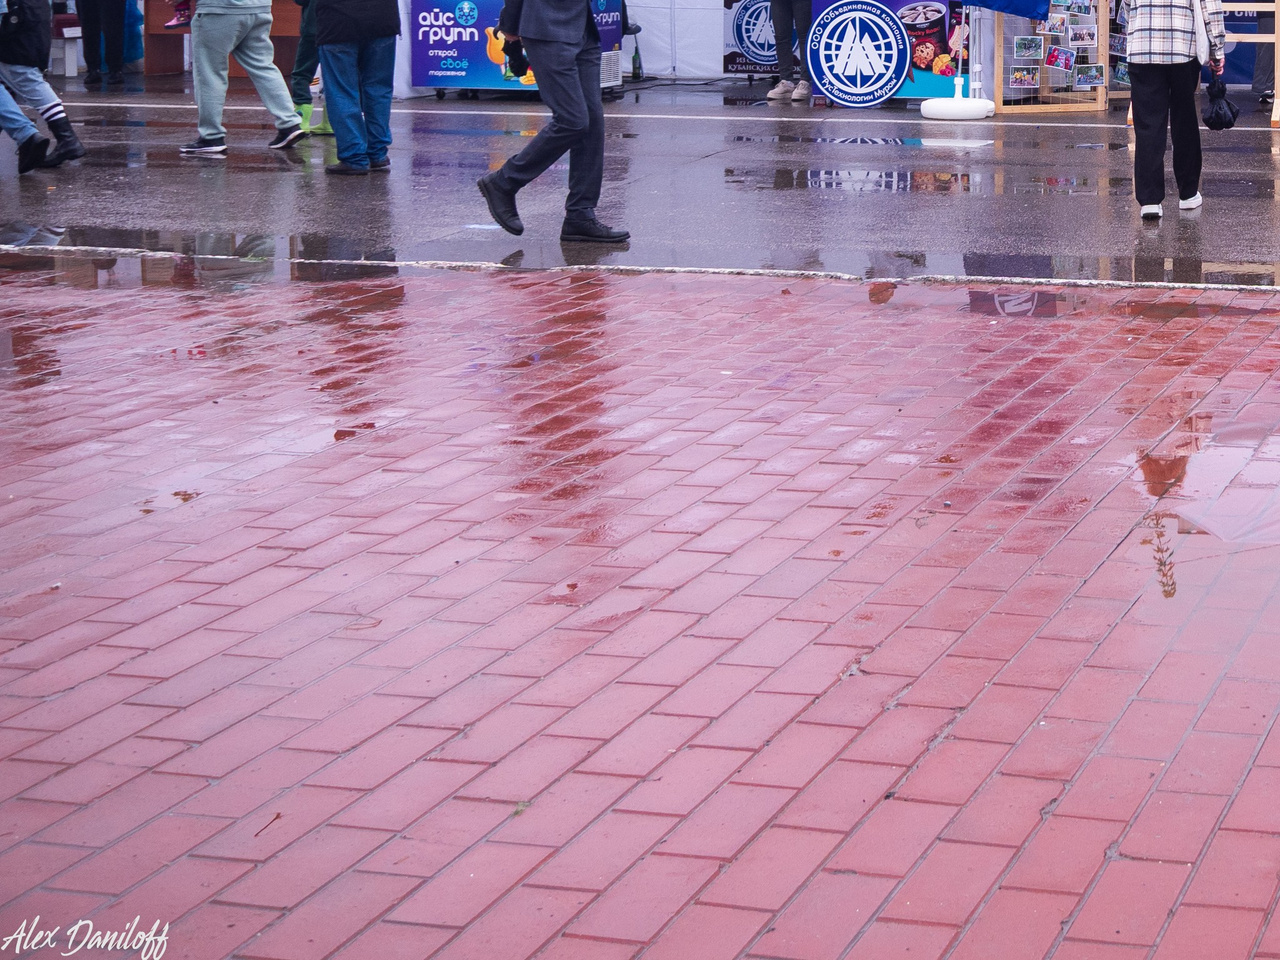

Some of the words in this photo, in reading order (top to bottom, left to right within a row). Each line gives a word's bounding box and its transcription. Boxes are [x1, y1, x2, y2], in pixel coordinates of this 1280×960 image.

[418, 8, 455, 26] айс
[418, 26, 479, 44] групп
[811, 26, 823, 50] ООО
